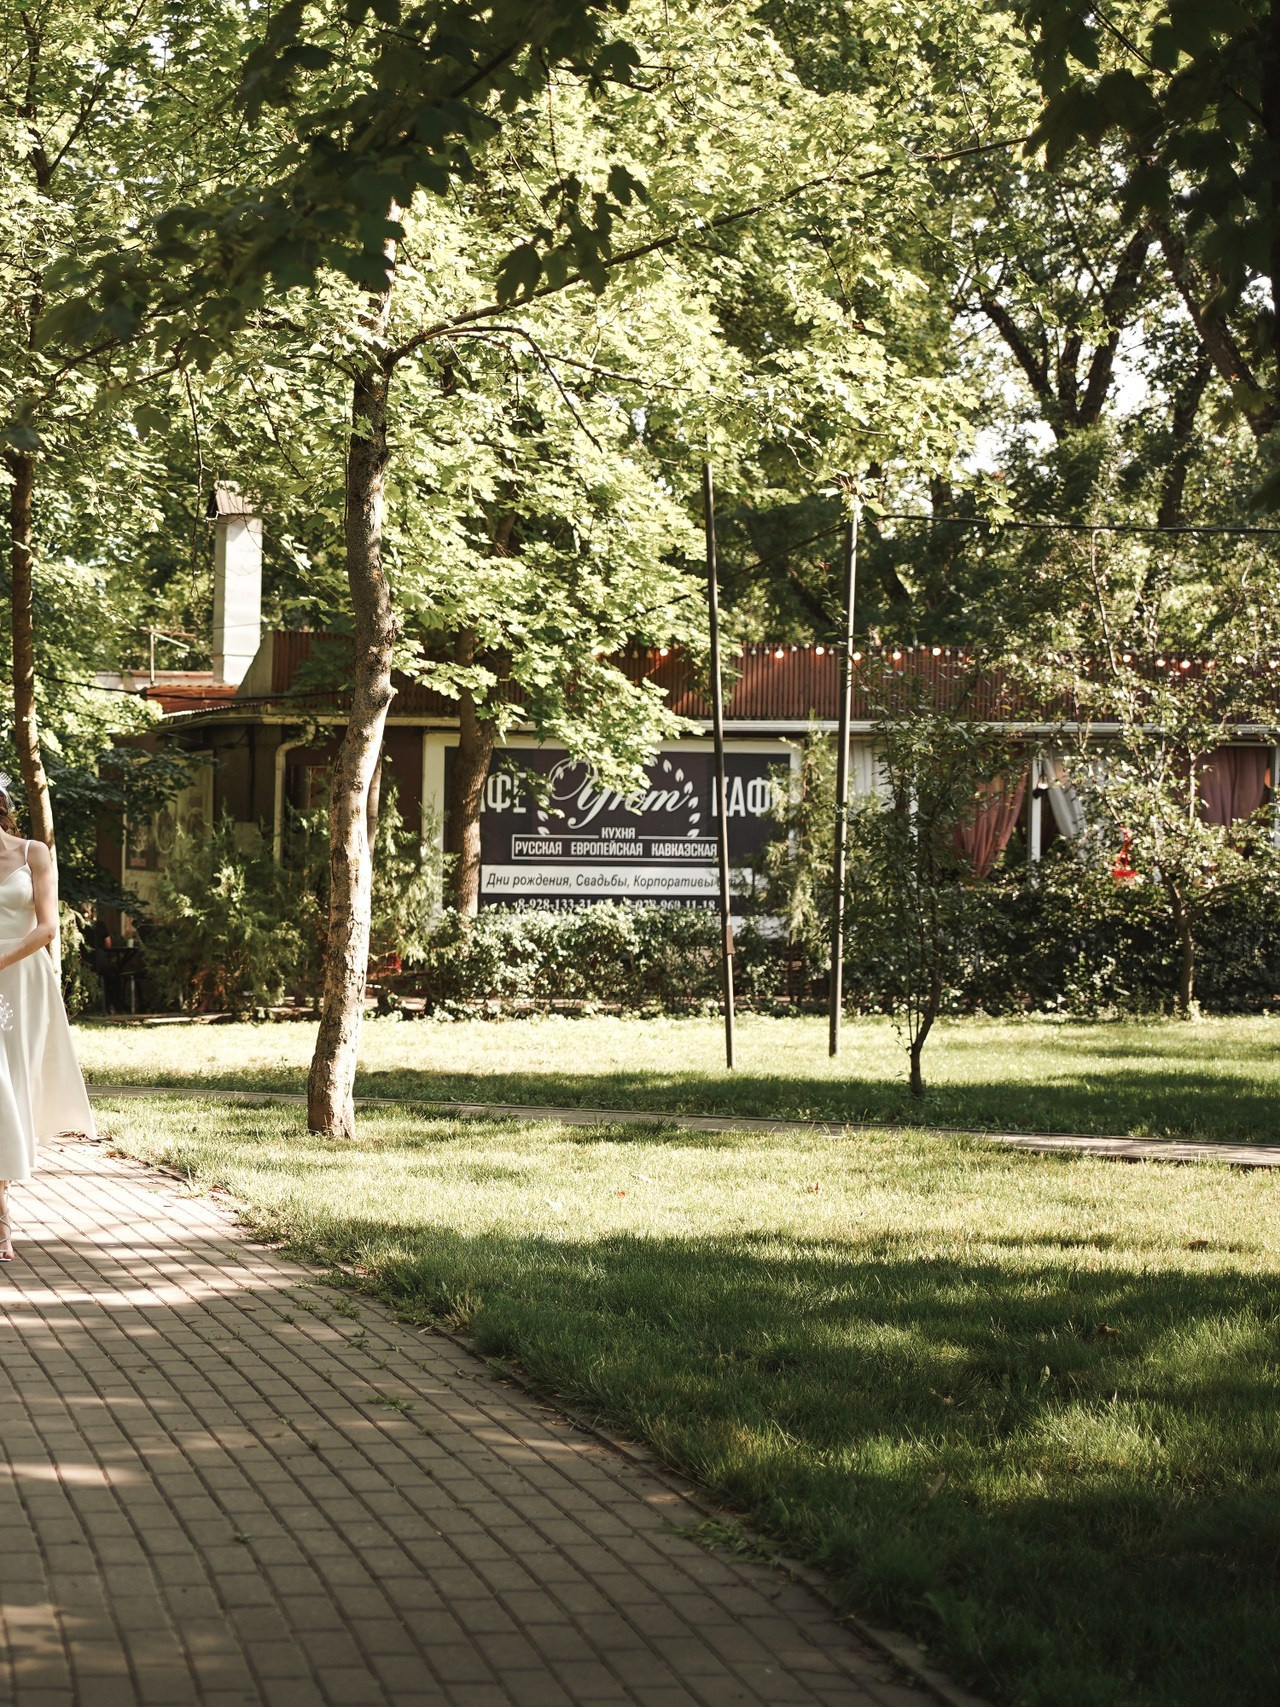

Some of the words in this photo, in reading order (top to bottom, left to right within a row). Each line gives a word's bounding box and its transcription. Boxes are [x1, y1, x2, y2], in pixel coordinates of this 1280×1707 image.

[480, 772, 527, 813] ФЕ
[712, 776, 786, 817] КАФ
[601, 826, 636, 840] КУХНЯ
[515, 841, 562, 855] РУССКАЯ
[570, 840, 643, 856] ЕВРОПЕЙСКАЯ
[651, 842, 718, 857] КАВКАЗСКАЯ
[486, 873, 510, 888] Дни
[512, 873, 572, 888] рождения,
[576, 874, 630, 889] Свадьбы,
[633, 874, 714, 890] Корпоративы
